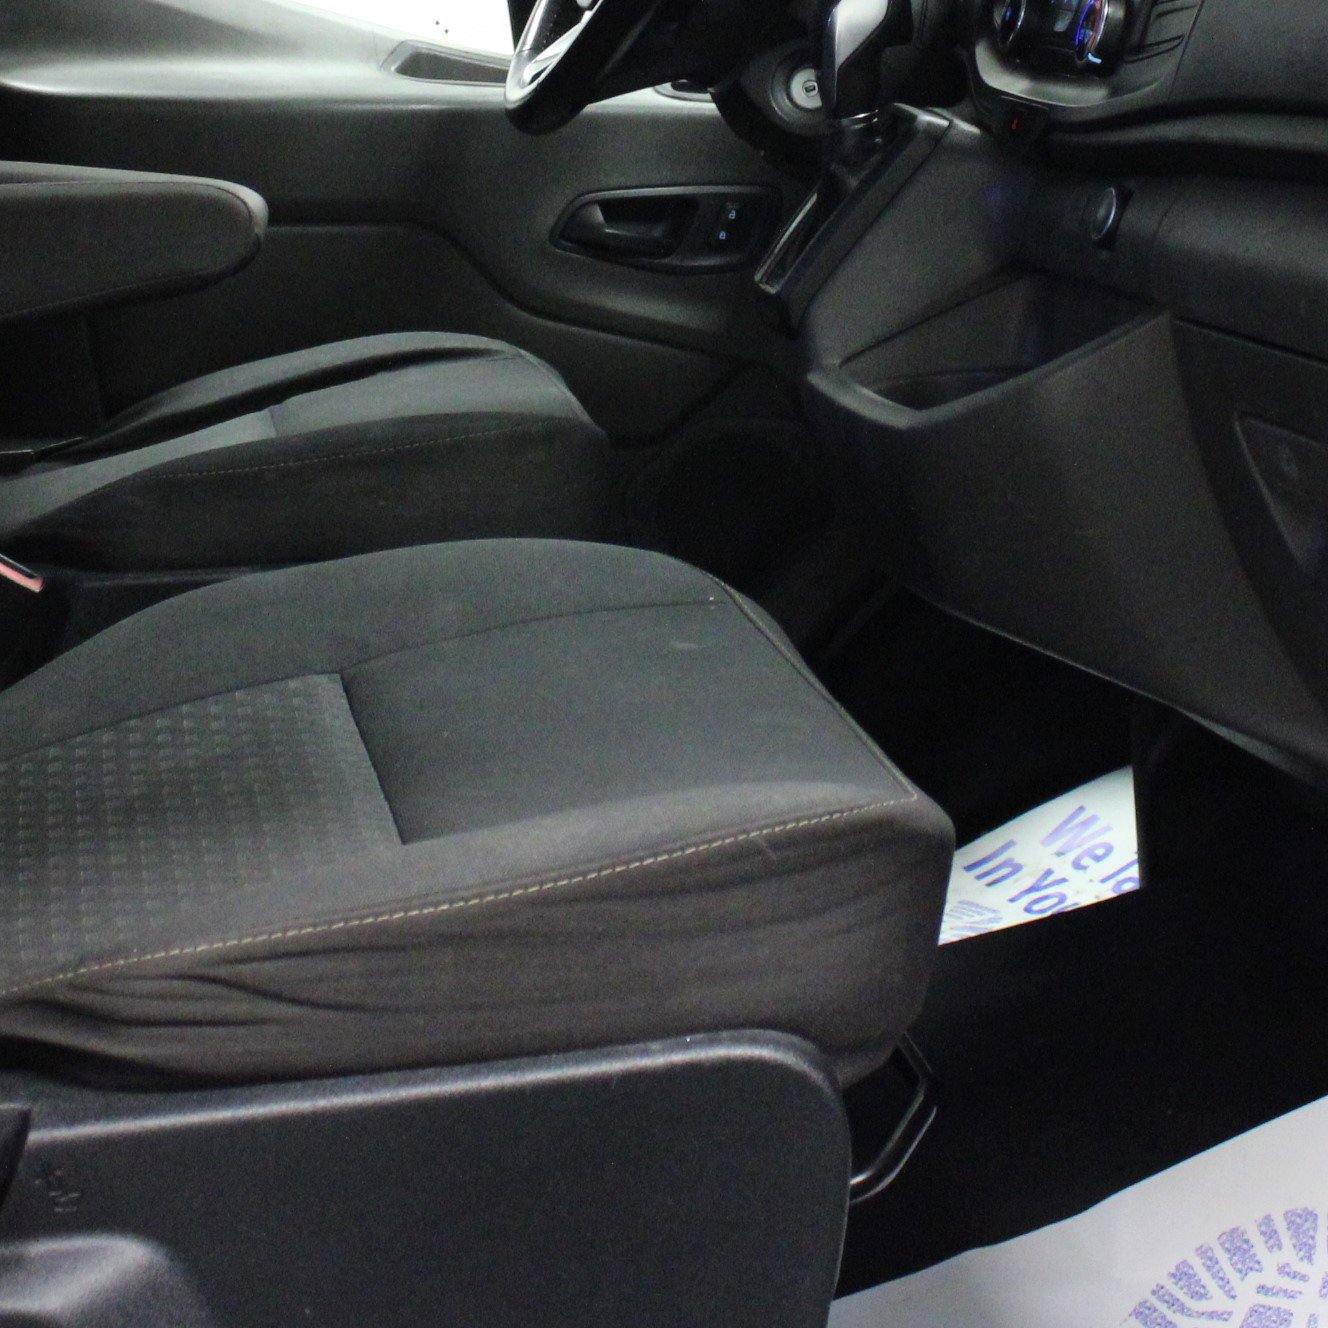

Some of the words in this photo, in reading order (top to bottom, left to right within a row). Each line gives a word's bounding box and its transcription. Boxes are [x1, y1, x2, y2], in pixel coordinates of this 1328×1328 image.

[1040, 804, 1114, 871] We
[963, 839, 1023, 888] In
[1007, 868, 1080, 915] Yo
